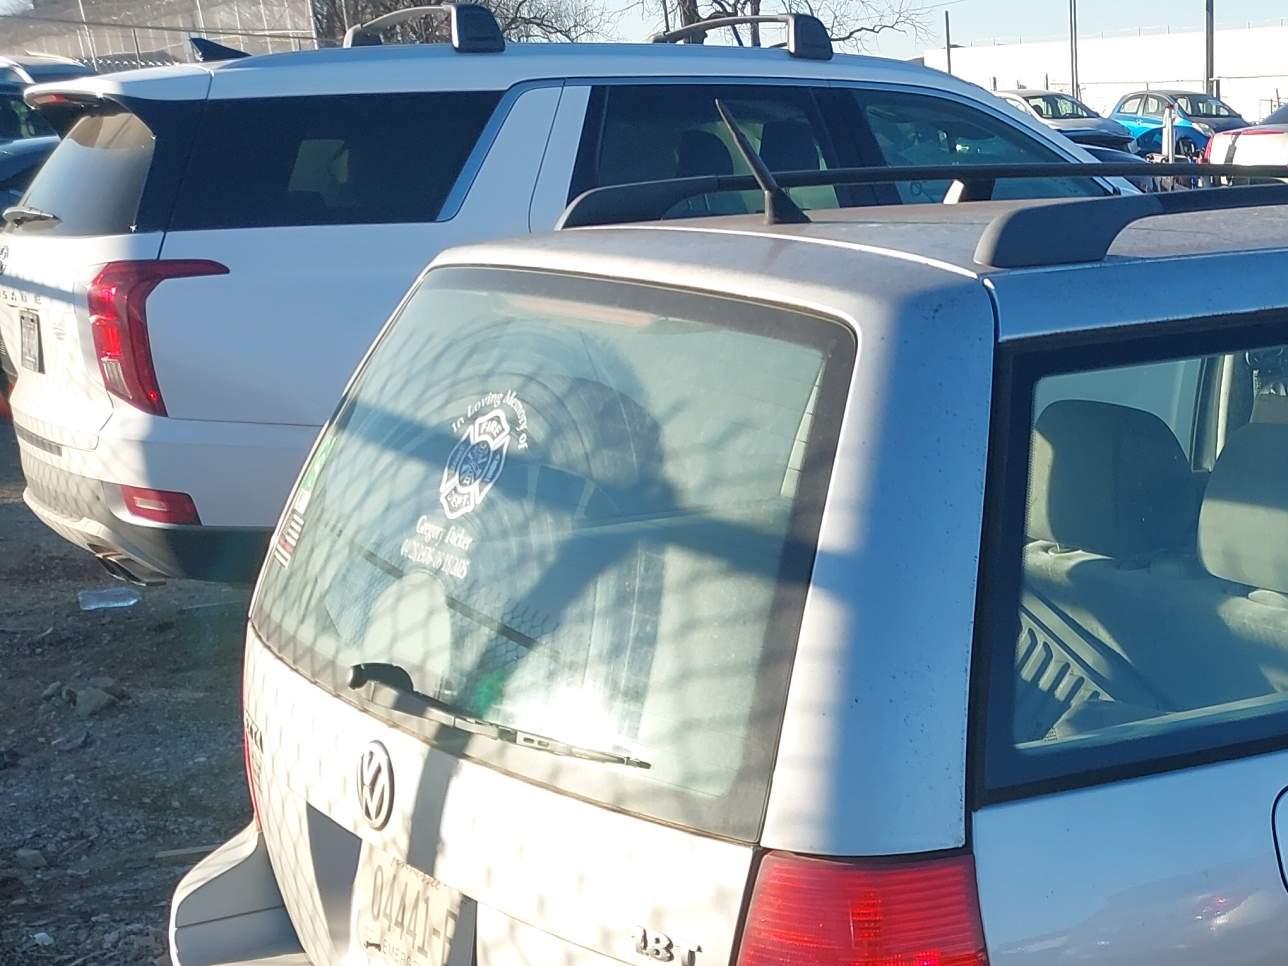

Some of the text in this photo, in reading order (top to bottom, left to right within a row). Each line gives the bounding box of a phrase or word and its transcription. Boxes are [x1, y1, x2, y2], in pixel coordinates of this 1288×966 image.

[451, 416, 467, 433] In
[467, 392, 504, 417] Loving
[503, 389, 528, 432] Memory
[480, 420, 502, 437] FIRE
